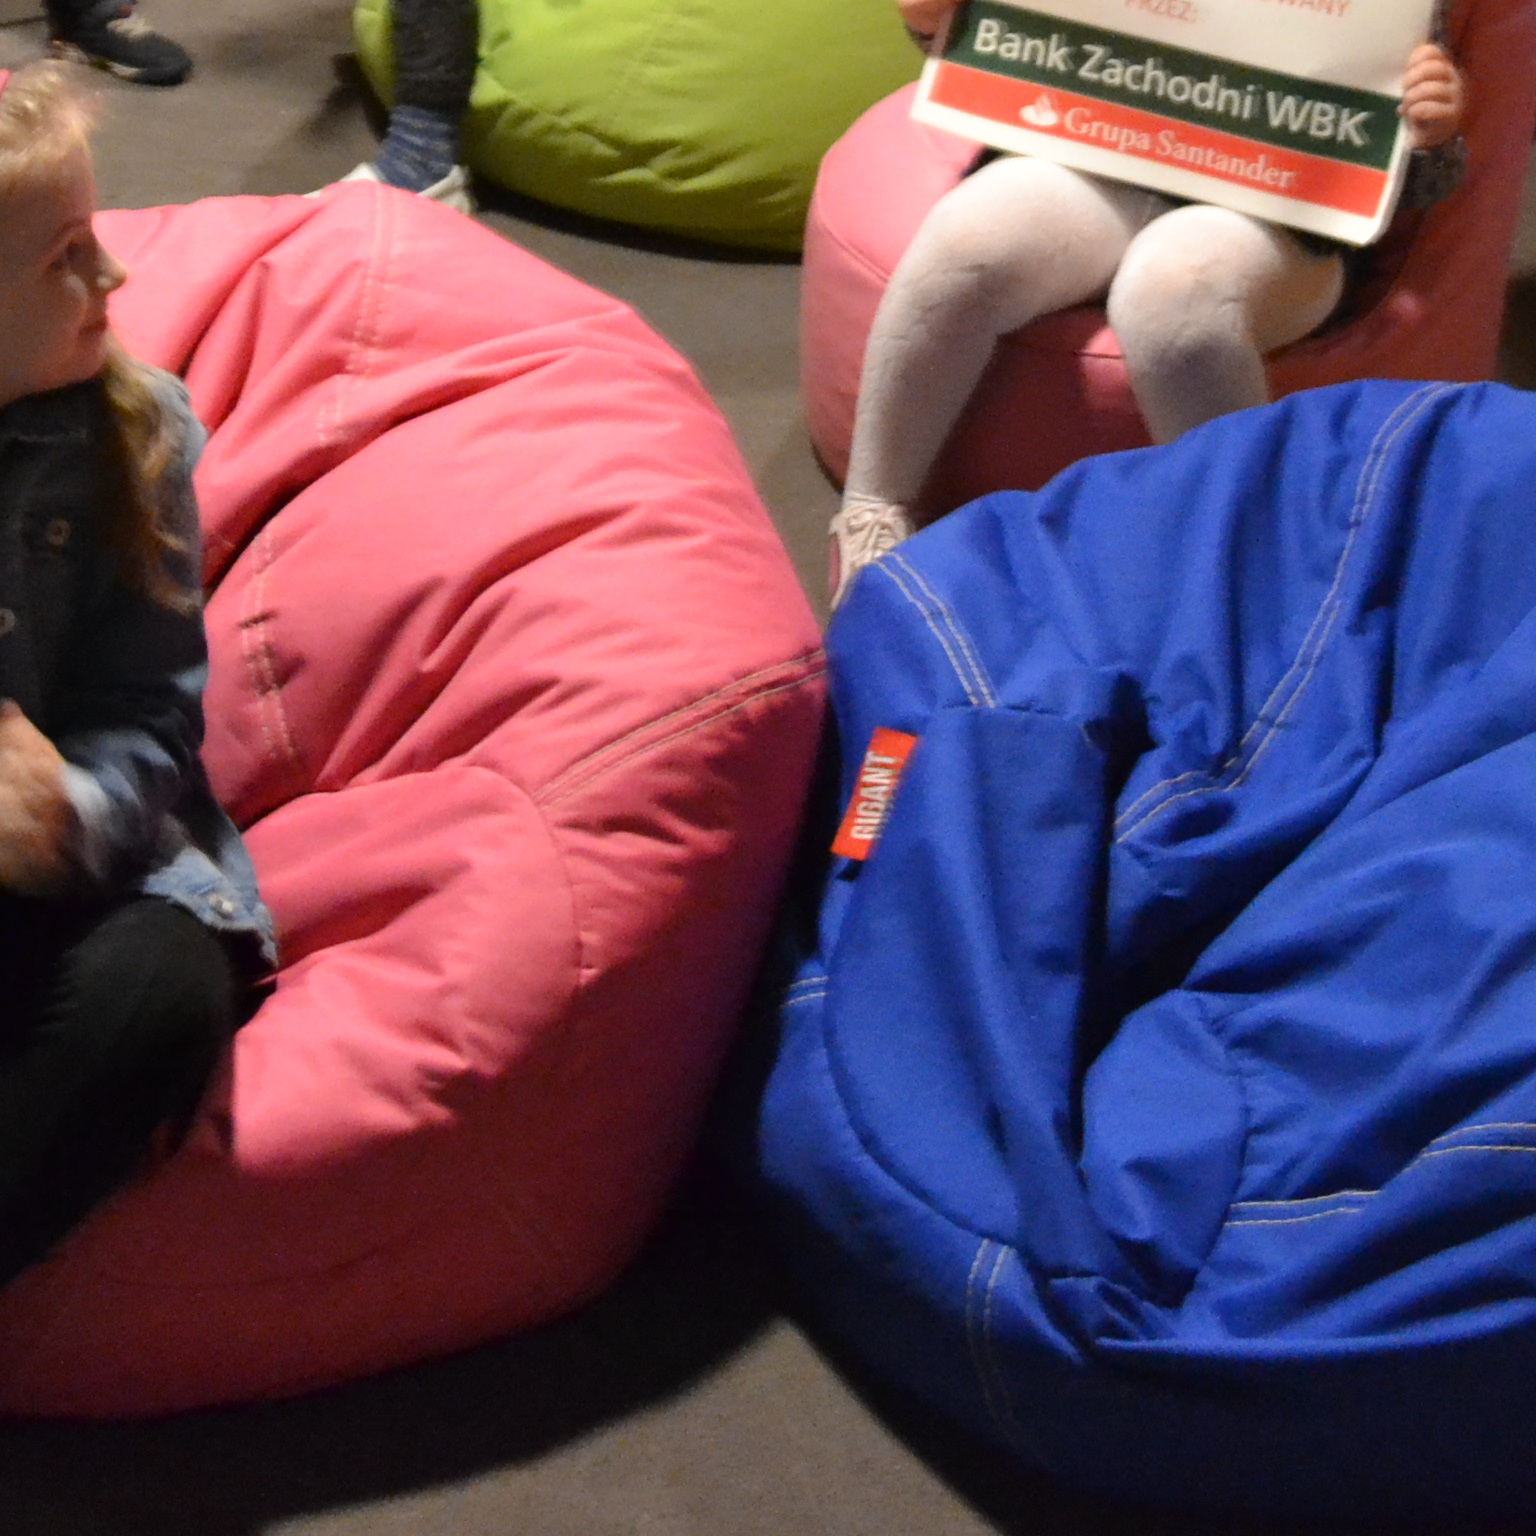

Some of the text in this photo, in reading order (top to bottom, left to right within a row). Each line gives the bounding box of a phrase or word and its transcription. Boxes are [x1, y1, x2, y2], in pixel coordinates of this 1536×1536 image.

[972, 17, 1369, 146] Bank Zachodni WBK
[1064, 106, 1296, 190] Grupa Santander
[850, 750, 898, 840] GIGANT
